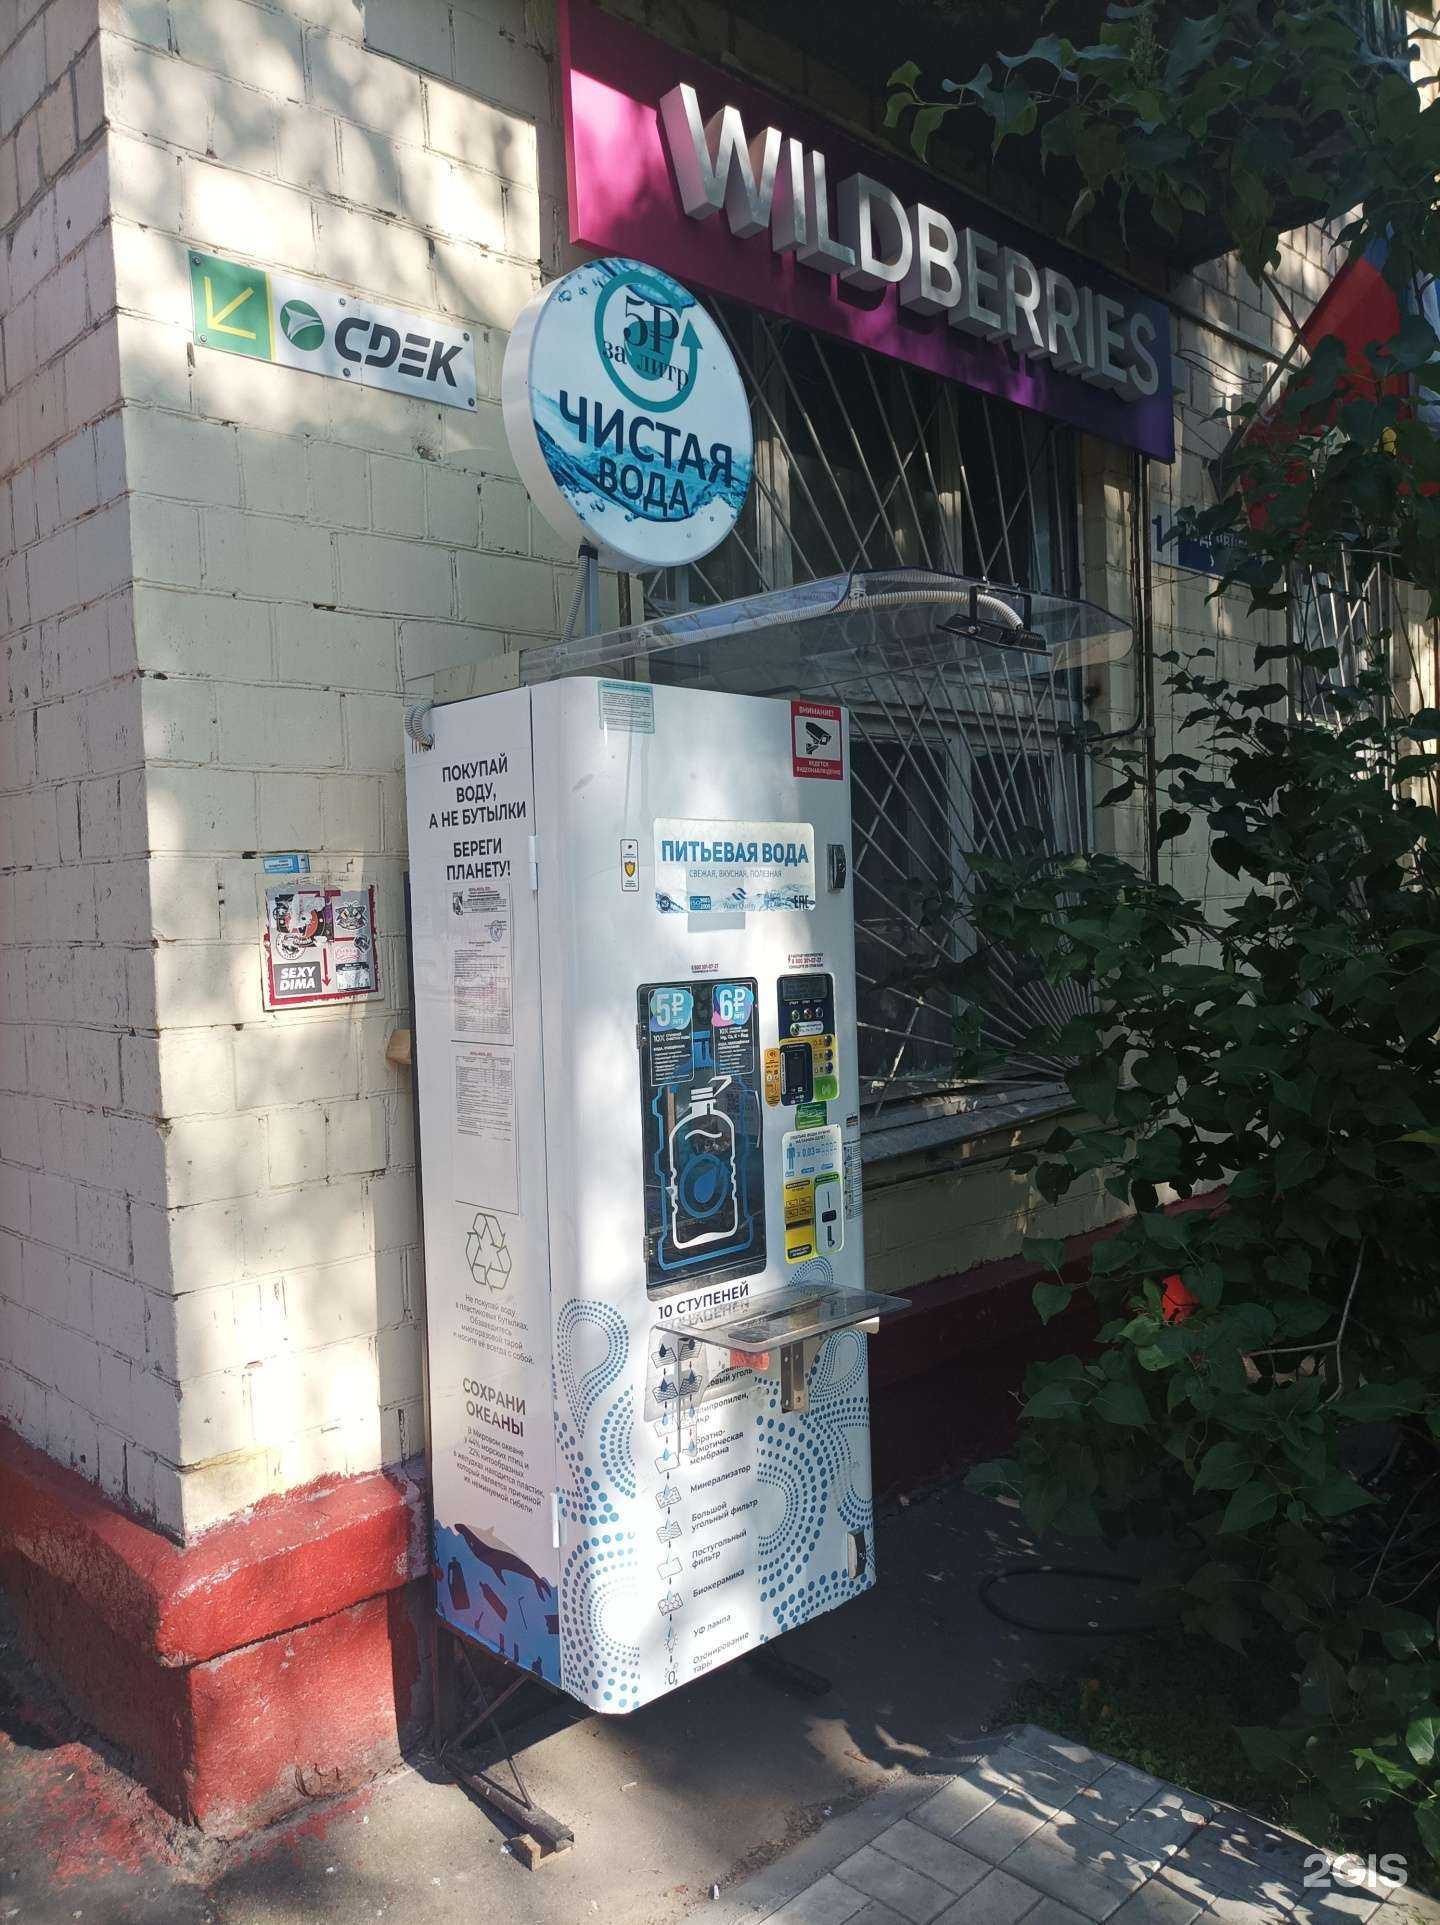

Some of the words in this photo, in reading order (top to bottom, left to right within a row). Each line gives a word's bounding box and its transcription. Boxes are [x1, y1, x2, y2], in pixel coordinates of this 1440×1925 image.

[661, 82, 1159, 398] WILDBERRIES
[334, 317, 463, 388] CDEK
[603, 341, 627, 365] за
[636, 361, 688, 392] литр
[559, 390, 733, 488] ЧИСТАЯ
[600, 456, 689, 518] ВОДА
[442, 752, 508, 782] ПОКУПАЙ
[456, 782, 497, 803] ВОДУ,
[429, 813, 439, 829] А
[441, 810, 459, 828] НЕ
[462, 801, 526, 825] БУТЫЛКИ
[453, 837, 502, 858] БЕРЕГИ
[661, 840, 758, 863] ПИТЬЕВАЯ
[762, 842, 809, 867] ВОДА
[446, 860, 511, 880] ПЛАНЕТУ!
[279, 978, 316, 991] DIMA
[280, 966, 316, 980] SEXY
[658, 1303, 673, 1320] 10
[677, 1280, 750, 1314] СТУПЕНЕЙ
[731, 1367, 753, 1382] уголь
[462, 1377, 526, 1416] СОХРАНИ
[466, 1400, 524, 1437] ОКЕАНЫ
[690, 1446, 729, 1465] мембрана
[690, 1465, 751, 1493] Минерализатор
[691, 1500, 727, 1521] Большой
[691, 1509, 729, 1533] угольный
[730, 1499, 758, 1516] фильтр
[692, 1528, 747, 1559] Постугольный
[691, 1551, 721, 1569] фильтр
[692, 1568, 745, 1597] Биокерамика
[693, 1625, 706, 1637] УФ
[707, 1614, 731, 1631] лампа
[693, 1632, 749, 1664] Озонирование
[693, 1660, 713, 1673] тары
